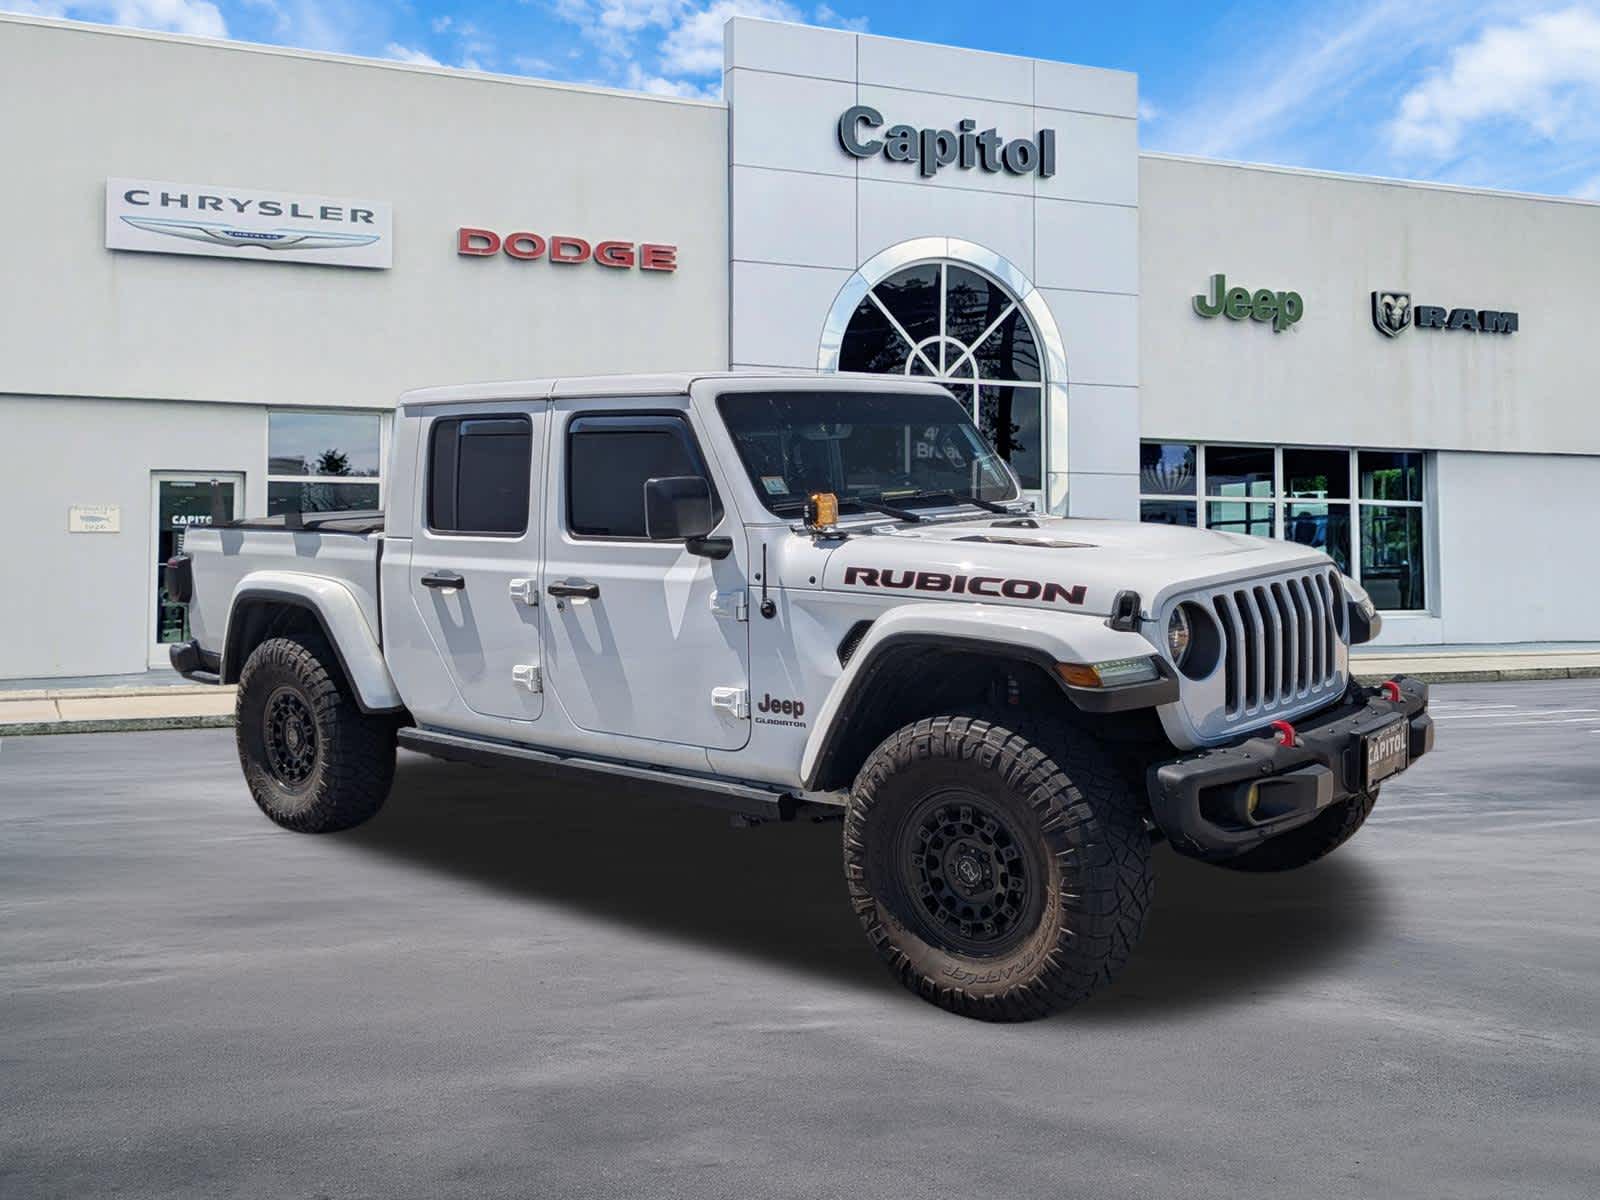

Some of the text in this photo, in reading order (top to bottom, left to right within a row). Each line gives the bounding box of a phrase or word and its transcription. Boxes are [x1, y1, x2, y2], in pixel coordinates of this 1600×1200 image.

[838, 105, 1056, 177] Capitol
[124, 189, 375, 224] CHRYSLER
[457, 227, 678, 272] DODGE
[1192, 273, 1304, 333] Jeep
[1414, 304, 1519, 334] RAM
[844, 566, 1087, 605] RUBICON
[755, 717, 806, 728] GLADIATOR
[758, 693, 804, 719] Jeep
[1368, 732, 1406, 765] CAPITOL
